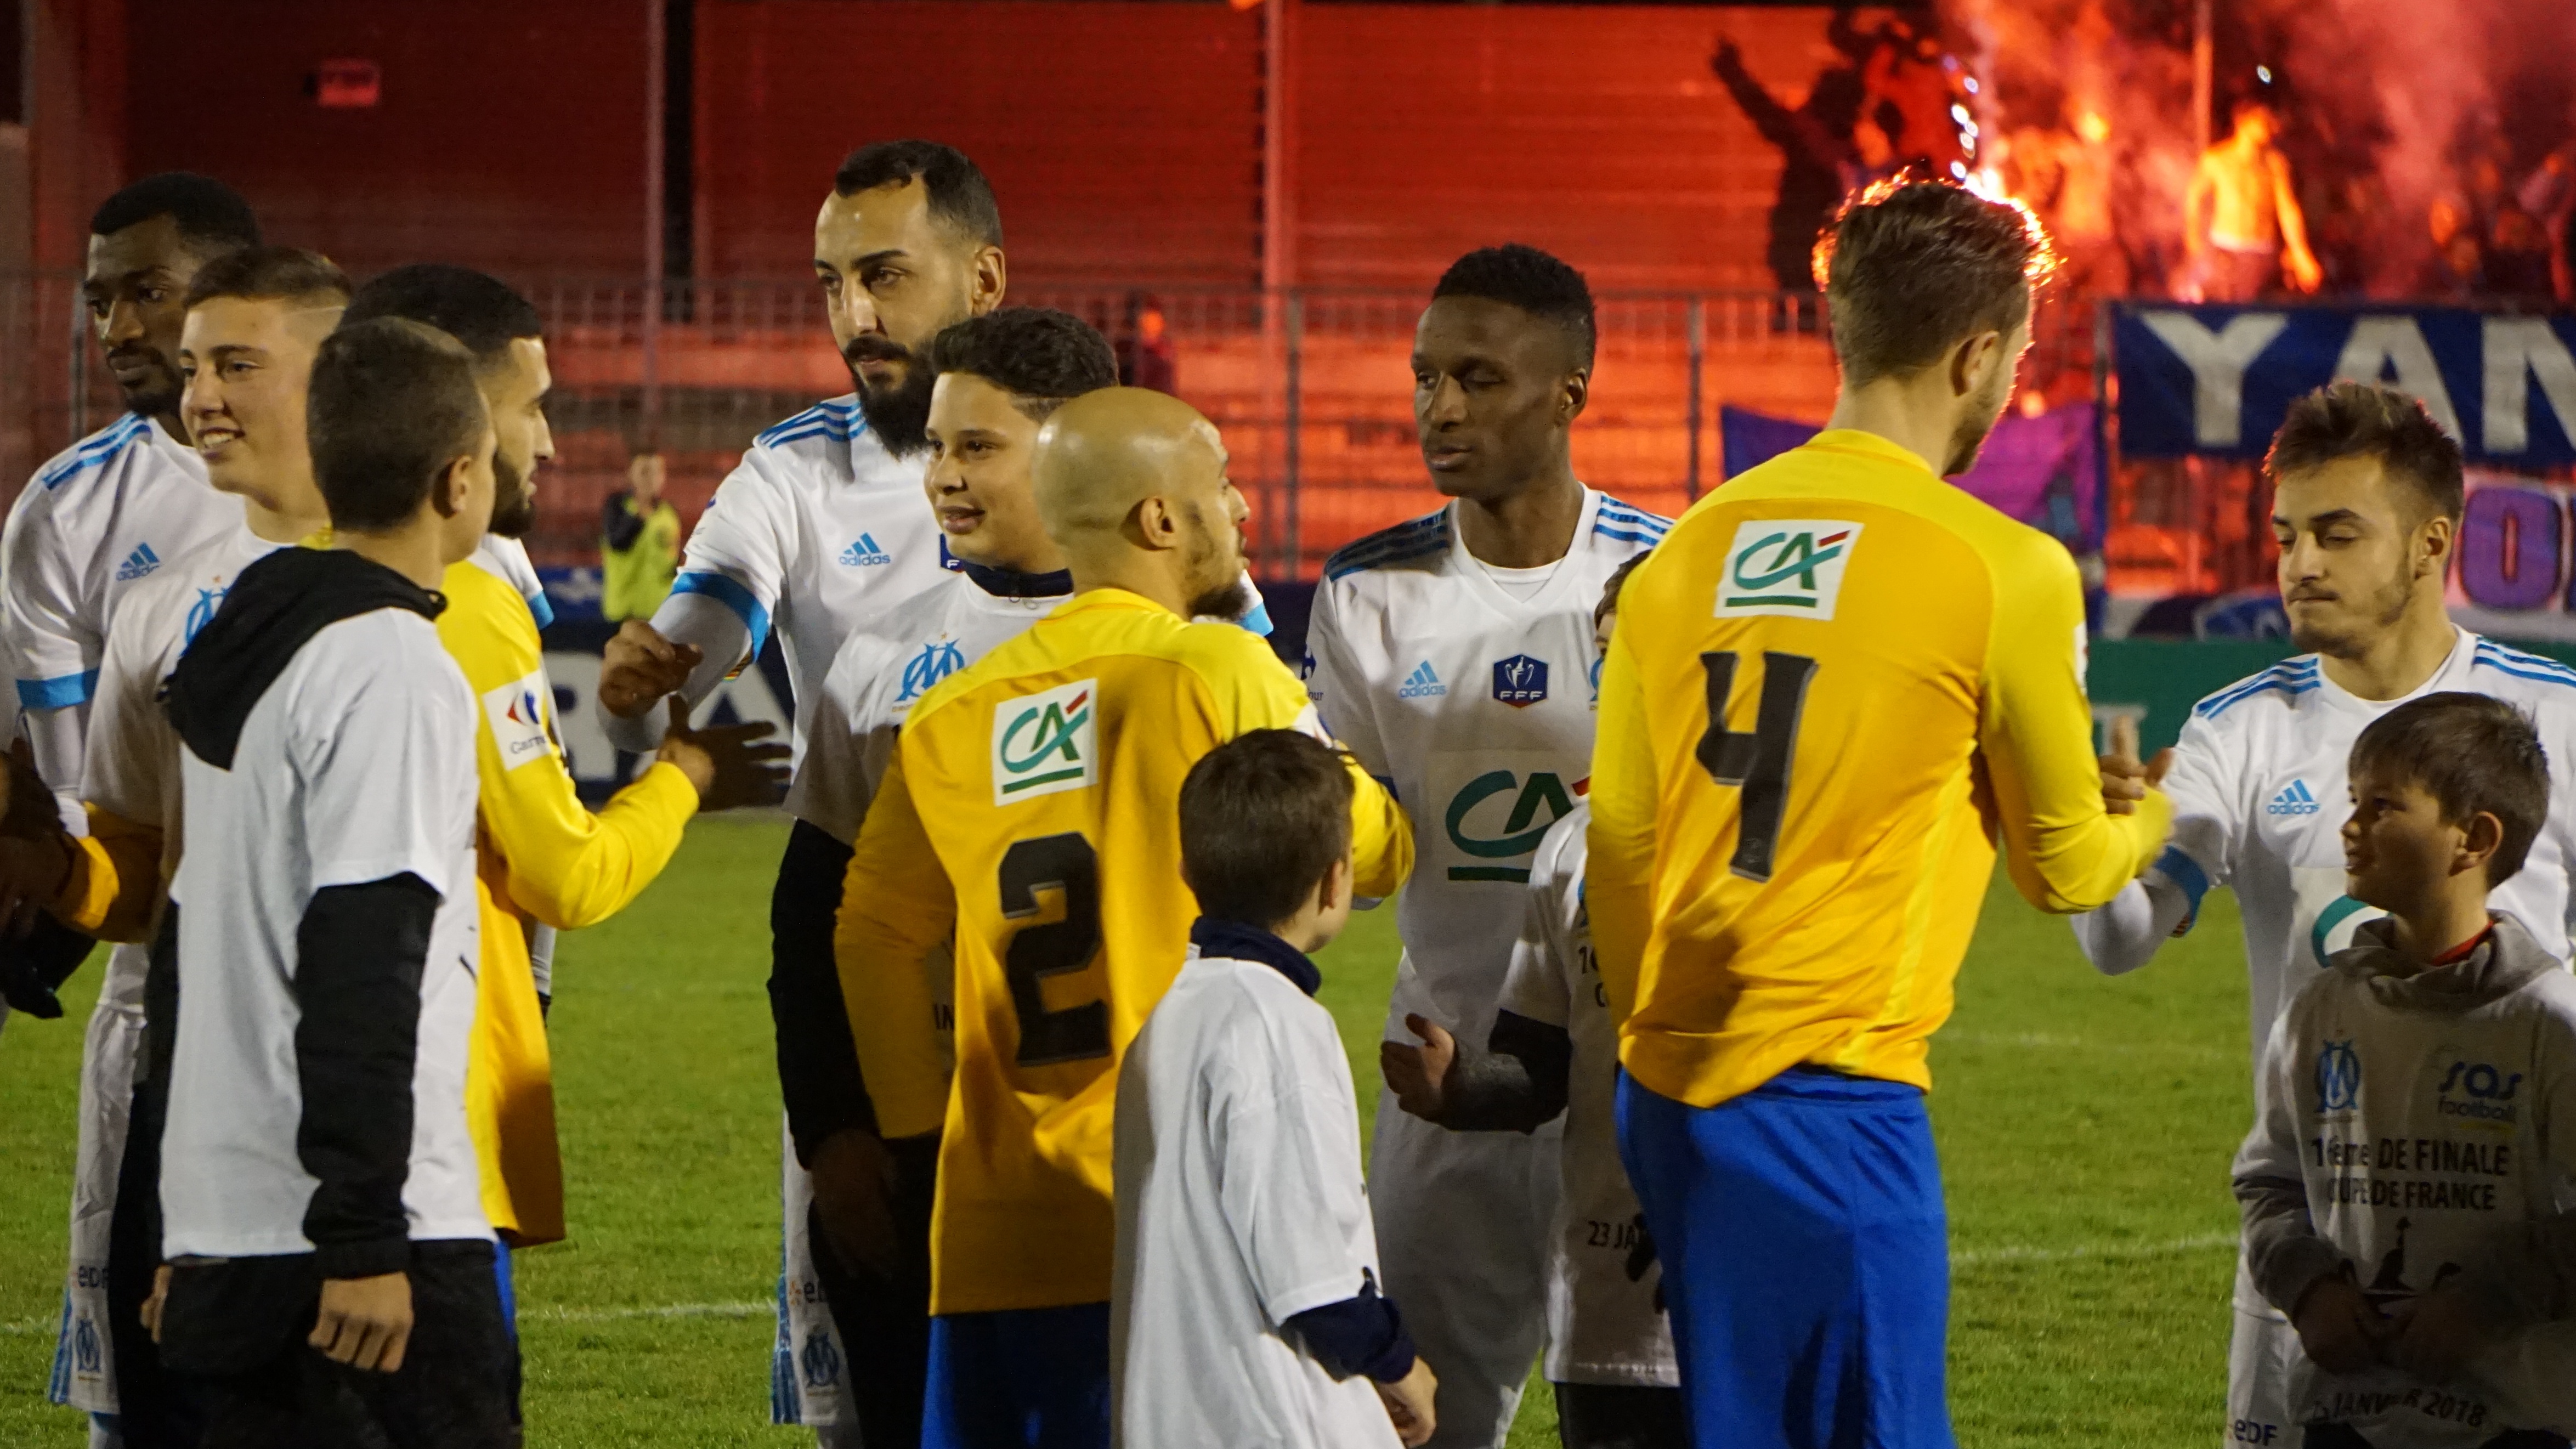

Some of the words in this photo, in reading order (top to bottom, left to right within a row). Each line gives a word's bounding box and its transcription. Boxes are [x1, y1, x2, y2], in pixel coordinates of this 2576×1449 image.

[839, 554, 891, 566] adidas
[1400, 683, 1447, 698] adidas
[1499, 690, 1543, 700] FFF
[1695, 651, 1820, 883] 4
[2266, 802, 2321, 815] adidas
[998, 831, 1112, 1067] 2
[2377, 1138, 2408, 1170] DE
[2415, 1139, 2511, 1176] FINALE
[2371, 1180, 2401, 1208] DE
[2404, 1181, 2496, 1210] FRANCE
[2423, 1392, 2487, 1428] 2018
